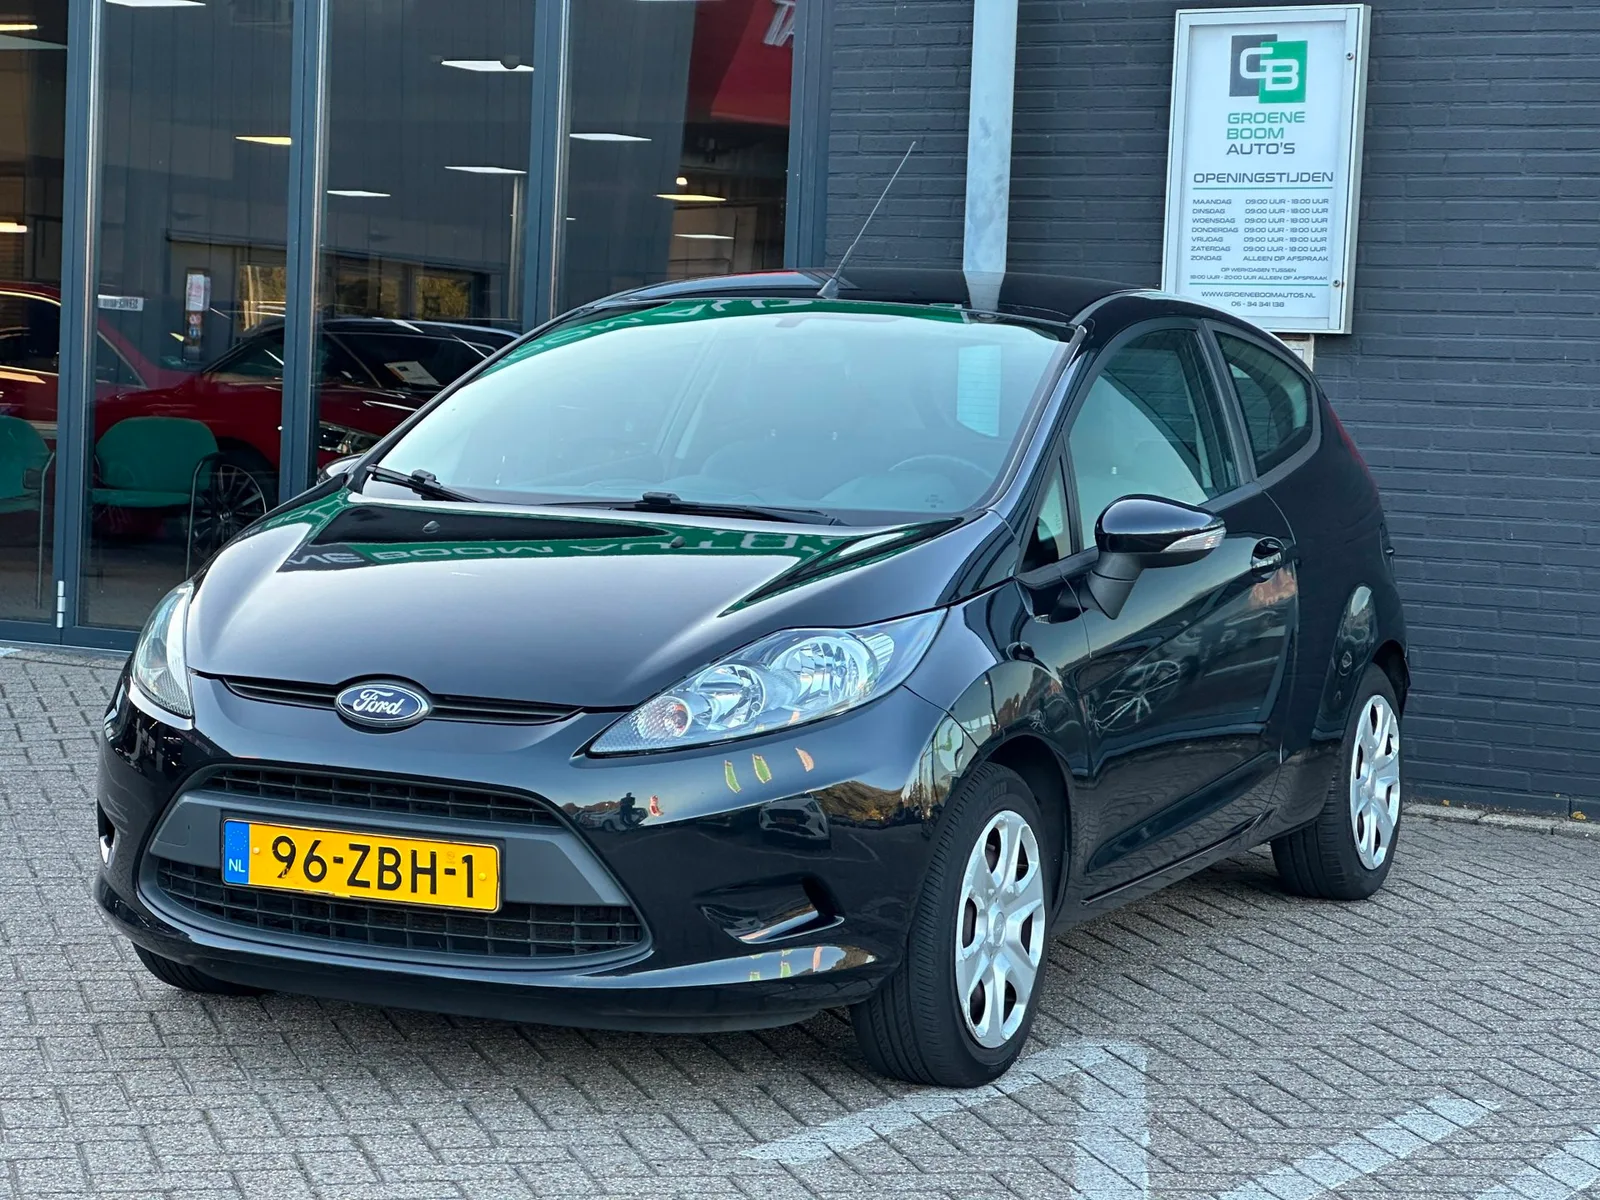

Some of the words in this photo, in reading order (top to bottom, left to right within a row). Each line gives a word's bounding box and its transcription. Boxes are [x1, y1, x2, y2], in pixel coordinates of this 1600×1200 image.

[1239, 47, 1300, 92] GB
[1227, 111, 1306, 125] GROENE
[1226, 127, 1284, 140] BOOM
[1226, 142, 1296, 156] AUTO'S
[1193, 171, 1334, 184] OPENINGSTIJDEN
[352, 688, 406, 716] Ford
[228, 857, 246, 874] NL
[271, 834, 475, 899] 96-ZBH-1
